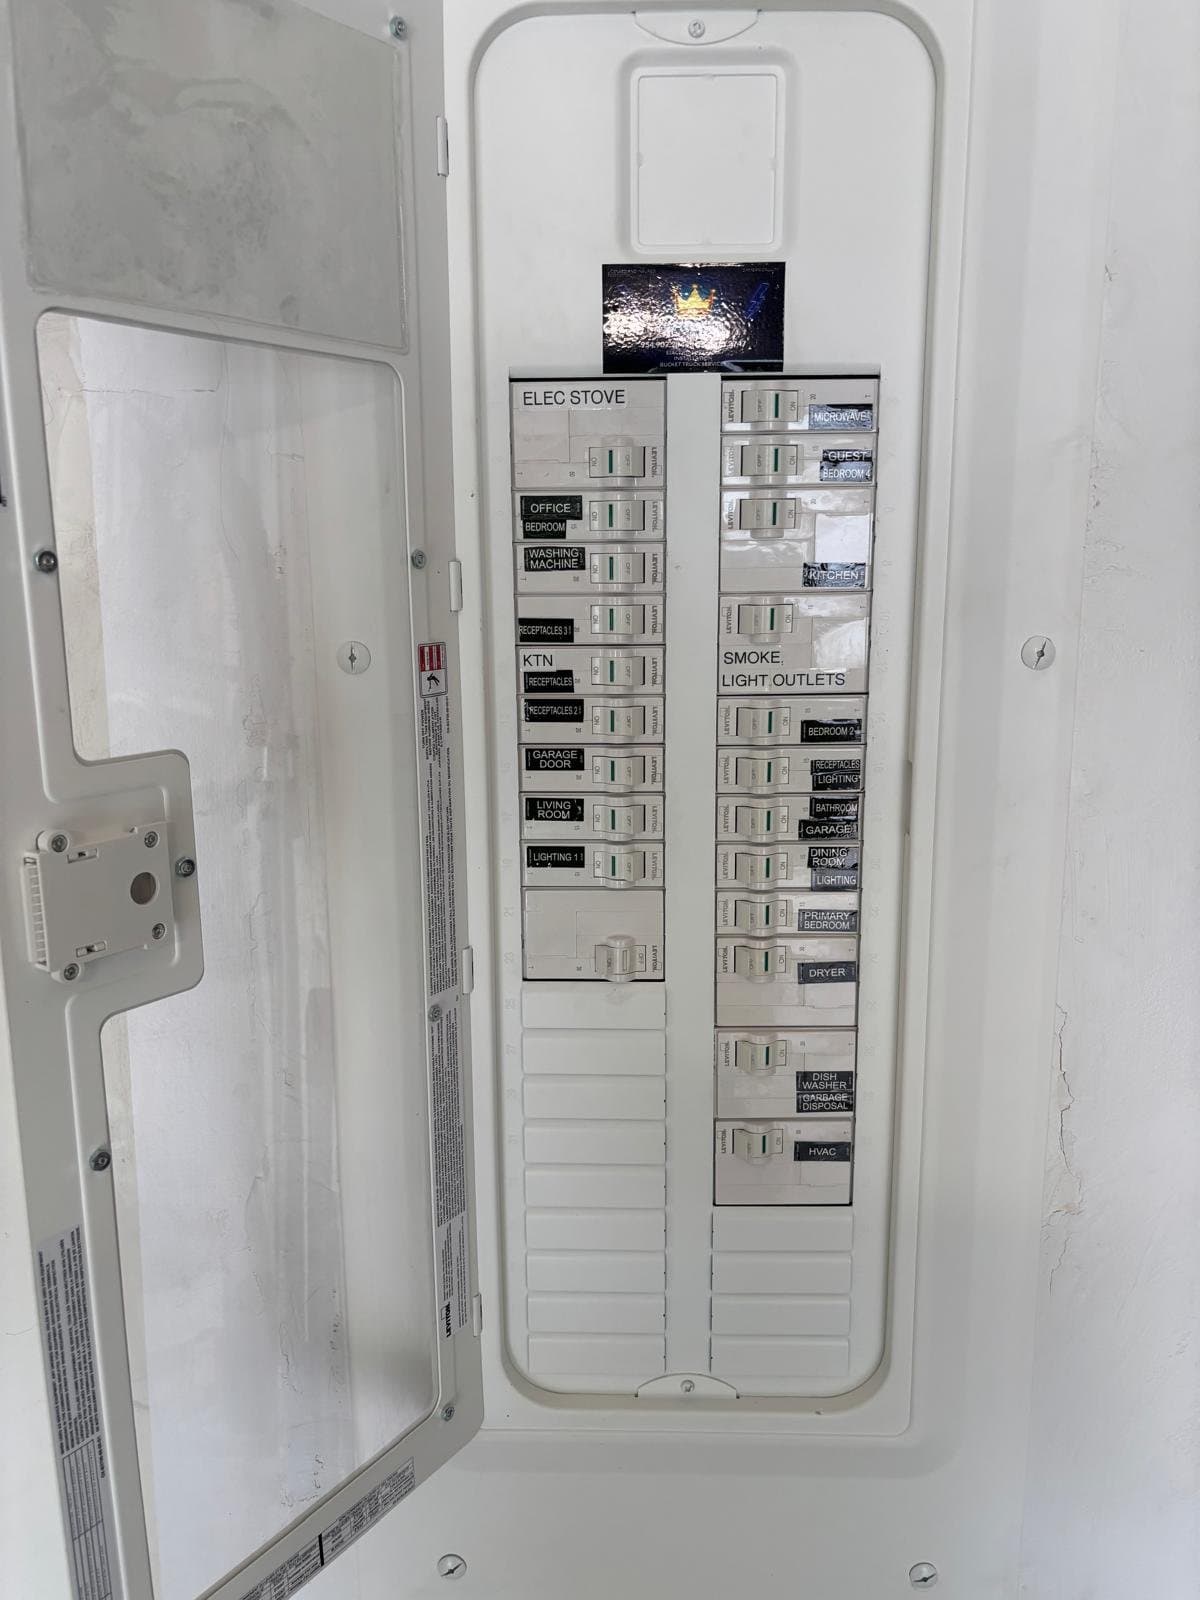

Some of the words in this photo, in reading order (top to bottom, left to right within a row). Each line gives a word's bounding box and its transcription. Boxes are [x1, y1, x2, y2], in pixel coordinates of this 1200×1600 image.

[522, 390, 566, 406] ELEC
[570, 389, 626, 406] STOVE
[814, 411, 866, 422] MICROWAVE
[828, 451, 868, 462] GUEST
[822, 468, 864, 478] BEDROOM
[864, 468, 871, 478] 4
[530, 503, 572, 514] OFFICE
[525, 522, 566, 532] BEDROOM
[528, 549, 579, 558] WASHING
[530, 558, 578, 569] MACHINE
[810, 569, 858, 580] KITCHEN
[519, 626, 562, 635] RECEPTACLES
[563, 626, 568, 635] 3
[522, 654, 553, 667] KTN
[528, 676, 572, 686] RECEPTACLES
[722, 674, 768, 687] LIGHT
[772, 673, 846, 686] OUTLETS
[530, 705, 572, 715] RECEPTACLES
[572, 705, 578, 714] 2
[808, 727, 848, 737] BEDROOM
[849, 726, 854, 736] 2
[532, 750, 578, 760] GARAGE
[539, 760, 572, 769] DOOR
[816, 760, 860, 770] RECEPTACLES
[818, 774, 858, 784] LIGHTING
[536, 800, 571, 810] LIVING
[815, 802, 858, 812] BATHROOM
[538, 810, 570, 820] ROOM
[805, 824, 852, 834] GARAGE
[533, 851, 572, 862] LIGHTING
[574, 850, 578, 861] 1
[810, 848, 848, 858] DINING
[812, 857, 846, 866] ROOM
[816, 876, 857, 886] LIGHTING
[804, 912, 850, 920] PRIMARY
[804, 920, 850, 930] BEDROOM
[808, 968, 846, 978] DRYER
[812, 1072, 838, 1082] DISH
[802, 1081, 848, 1090] WASHER
[802, 1093, 848, 1102] GARBAGE
[802, 1102, 849, 1111] DISPOSAL
[808, 1147, 836, 1157] HVAC
